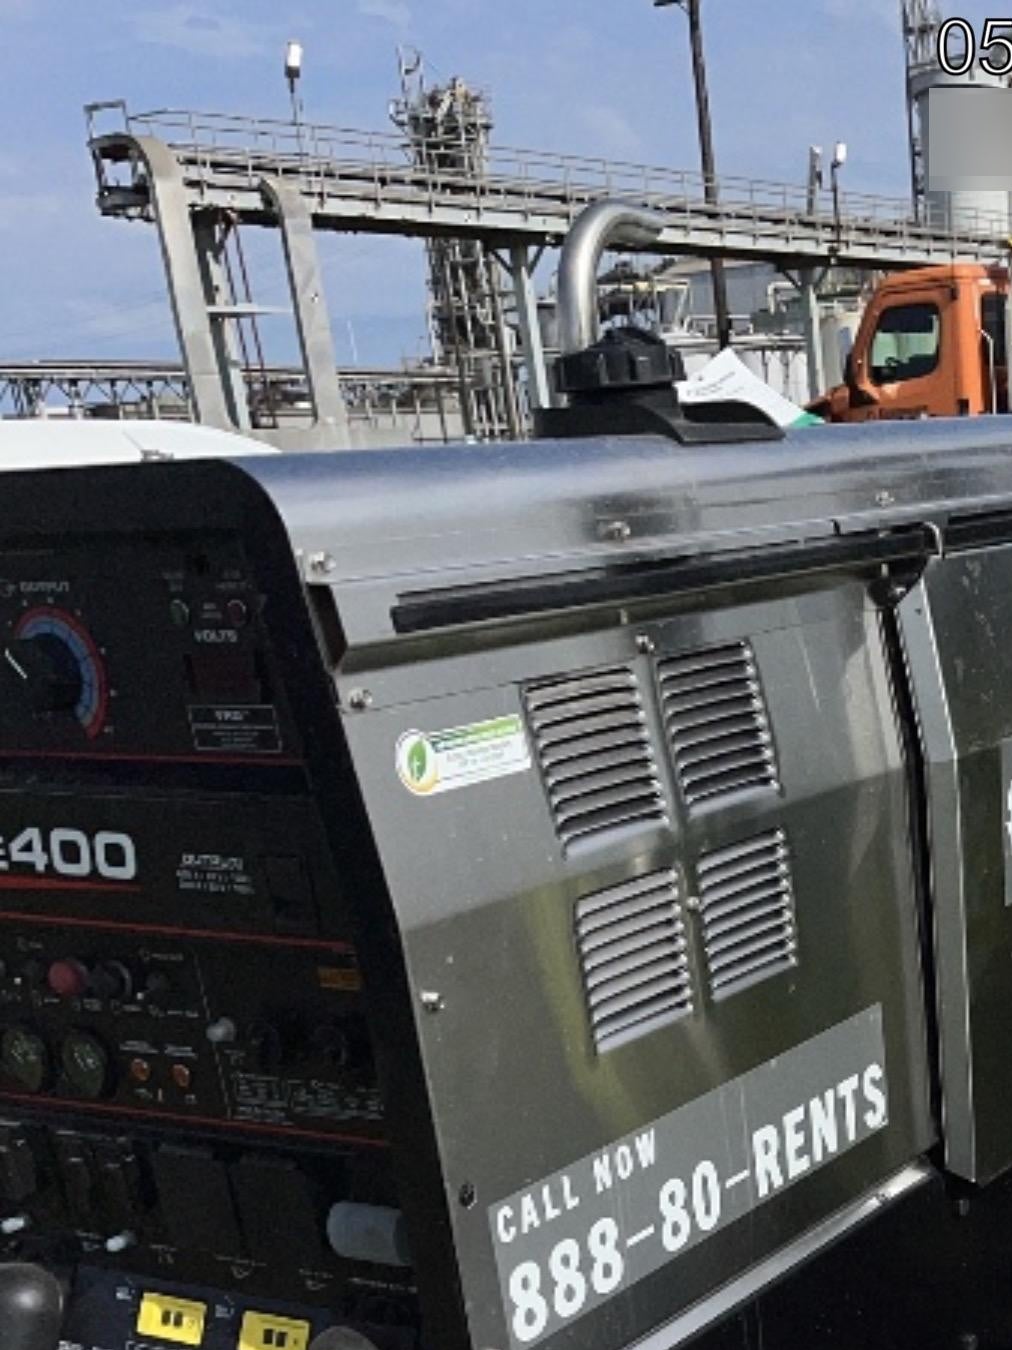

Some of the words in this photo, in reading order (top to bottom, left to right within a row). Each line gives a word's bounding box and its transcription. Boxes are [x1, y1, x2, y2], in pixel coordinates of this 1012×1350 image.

[496, 1174, 581, 1244] CALL
[592, 1127, 657, 1195] NOW
[507, 1062, 890, 1343] 888-80-RENTS
